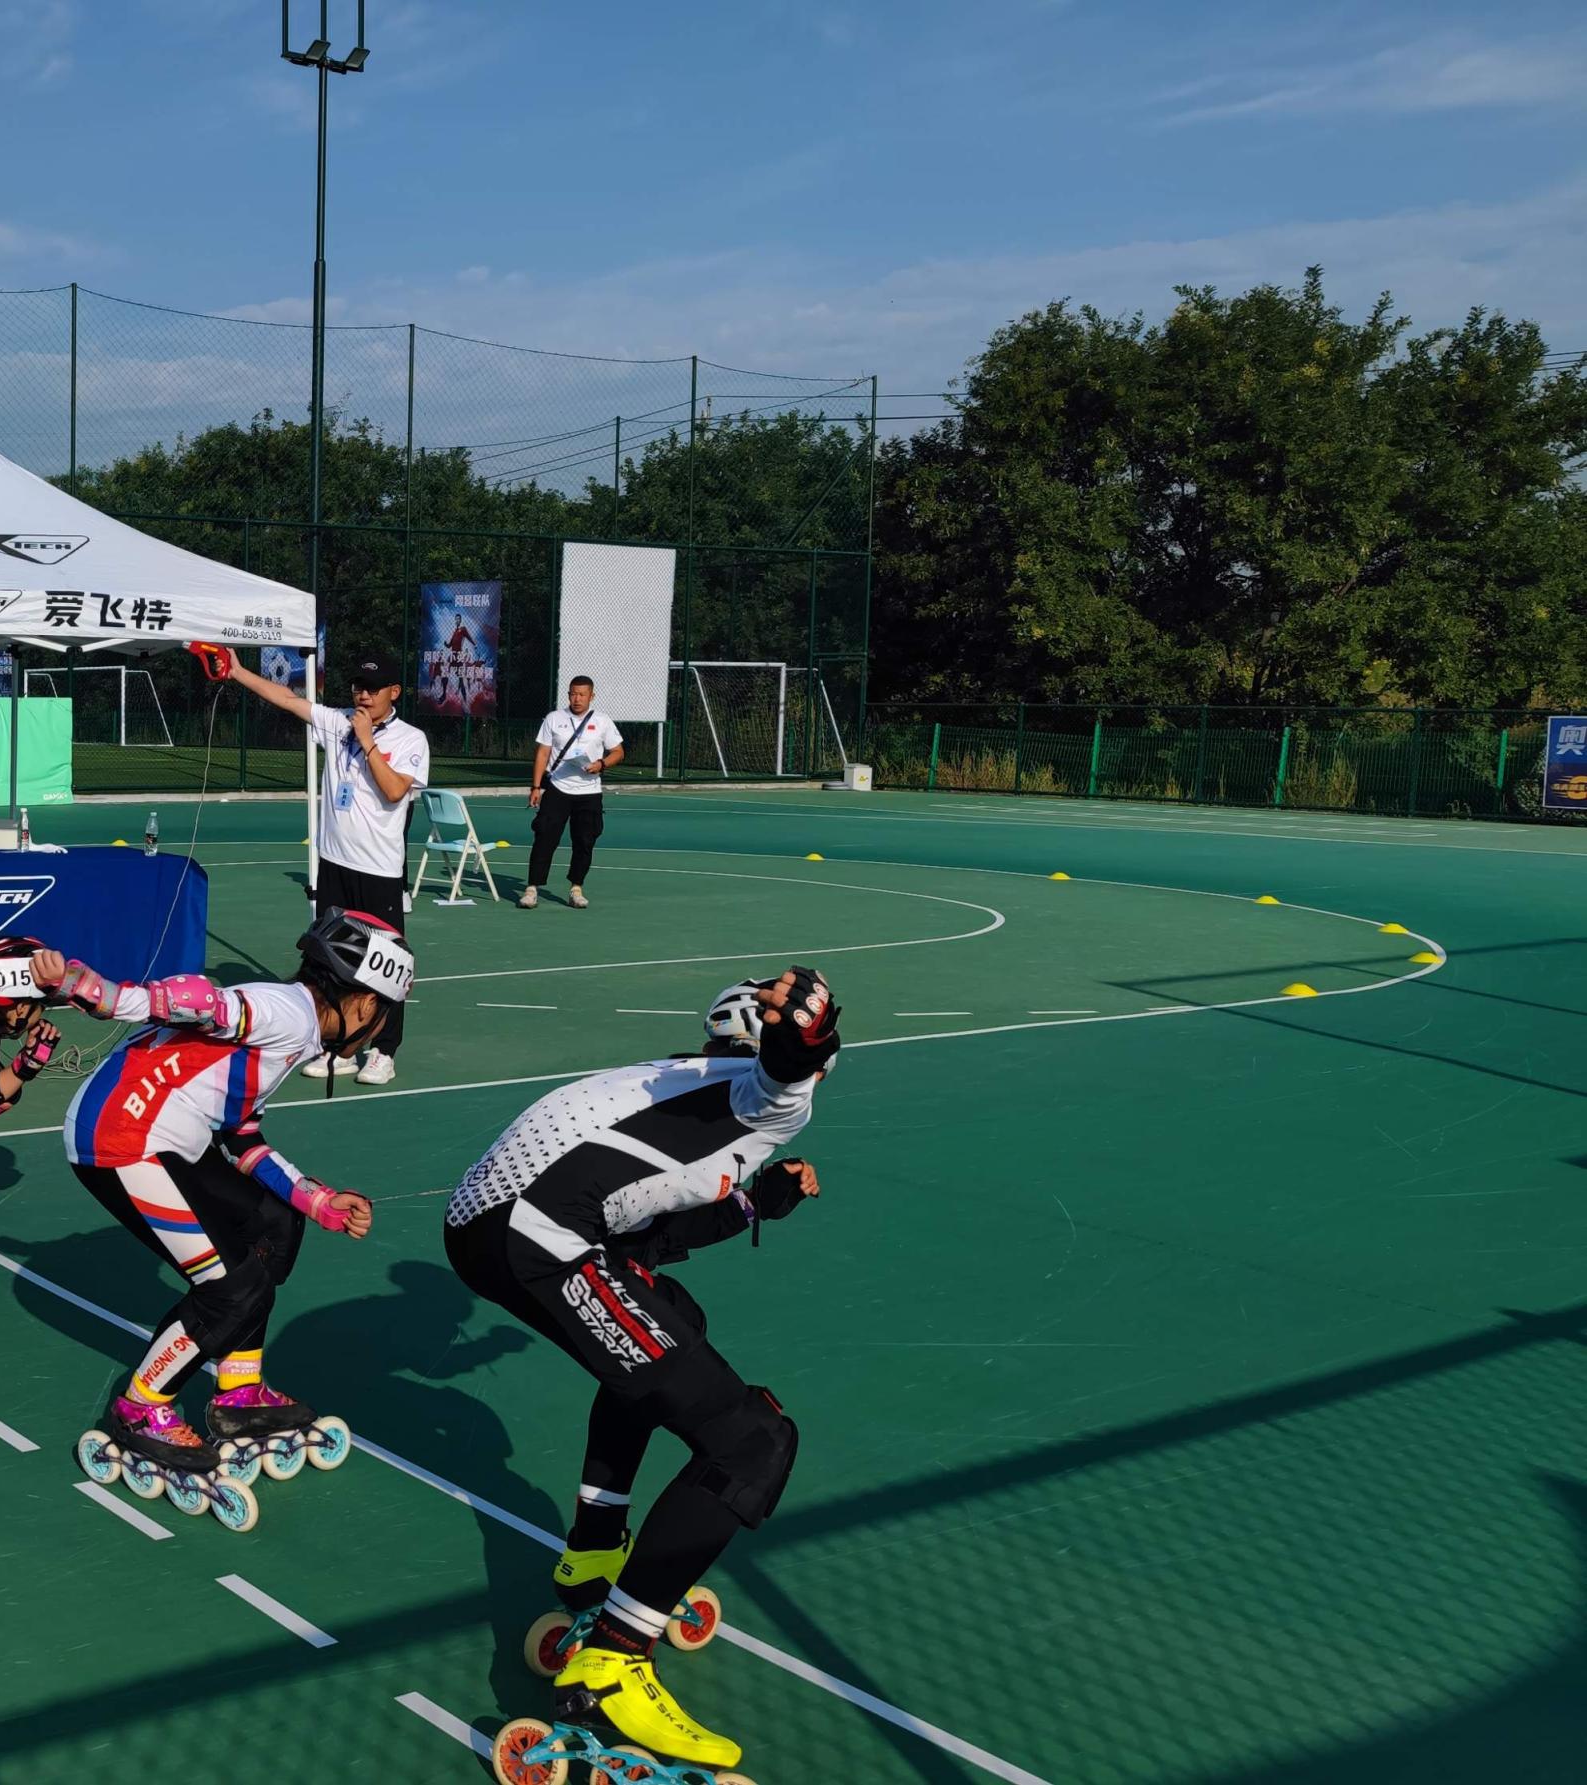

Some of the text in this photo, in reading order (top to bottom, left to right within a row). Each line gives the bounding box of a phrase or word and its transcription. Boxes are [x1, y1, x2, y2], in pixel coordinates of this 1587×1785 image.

[43, 590, 173, 631] 爱飞特
[243, 615, 283, 628] 服务电话
[122, 1051, 181, 1120] BJIT
[576, 1305, 630, 1359] START
[590, 1297, 652, 1364] SKATING
[630, 1665, 661, 1701] FS
[656, 1702, 704, 1742] SKATE
